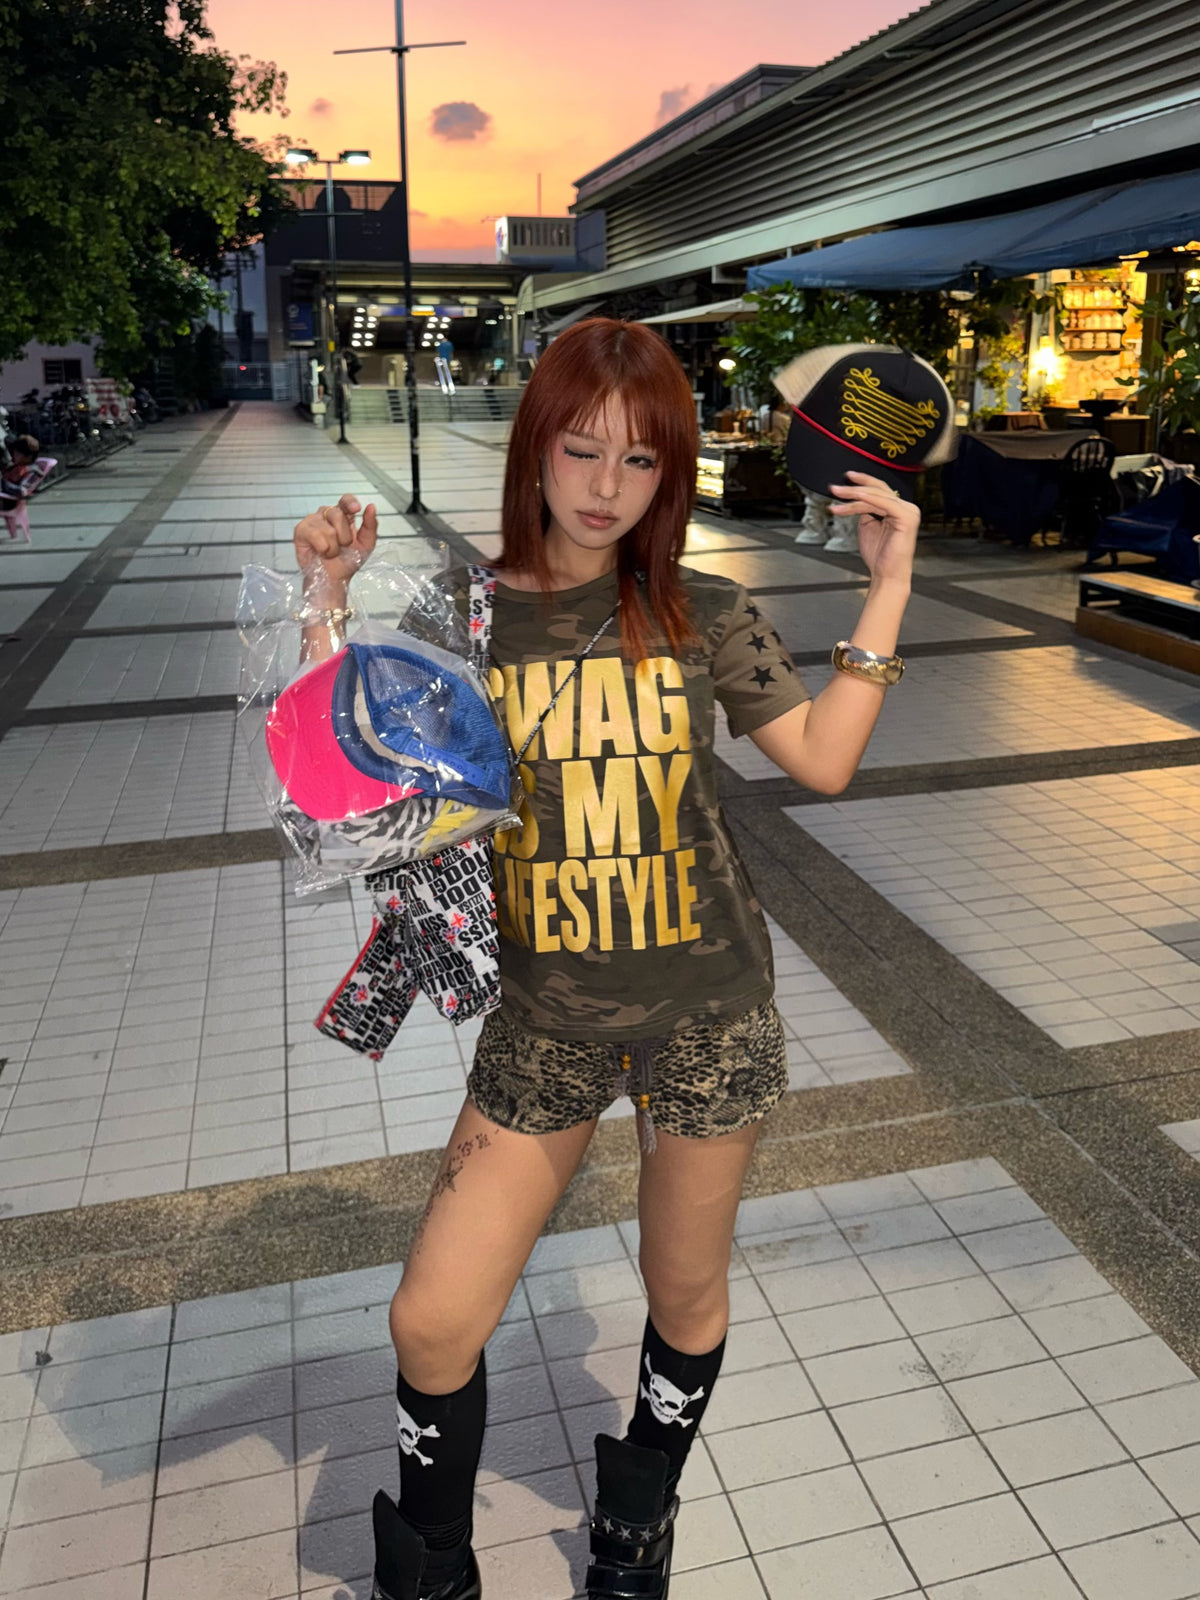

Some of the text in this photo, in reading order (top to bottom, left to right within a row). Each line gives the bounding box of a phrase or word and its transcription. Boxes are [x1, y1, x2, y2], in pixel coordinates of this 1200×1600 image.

[561, 753, 692, 857] MY
[457, 891, 486, 913] LIZLISA
[466, 899, 496, 924] THE
[418, 913, 449, 934] KISS
